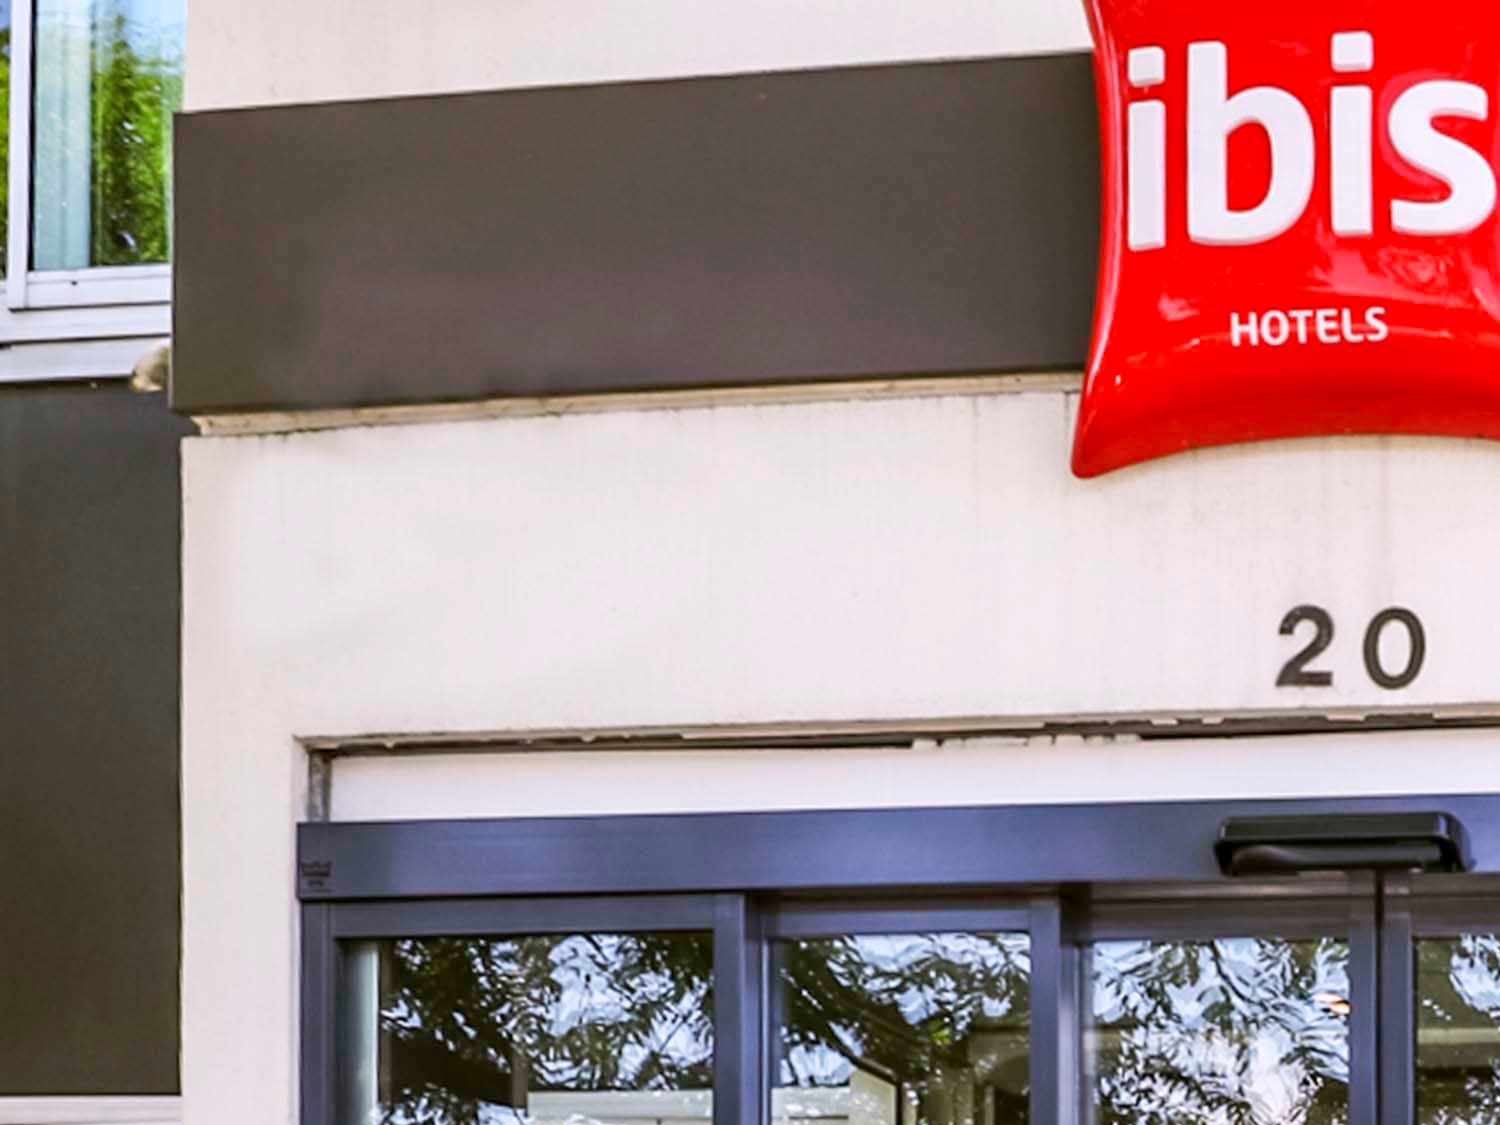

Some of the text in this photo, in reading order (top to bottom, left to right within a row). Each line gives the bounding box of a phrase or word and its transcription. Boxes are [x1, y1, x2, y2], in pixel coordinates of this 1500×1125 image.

[1127, 31, 1498, 252] ibis
[1230, 305, 1389, 347] HOTELS
[1275, 604, 1426, 690] 20
